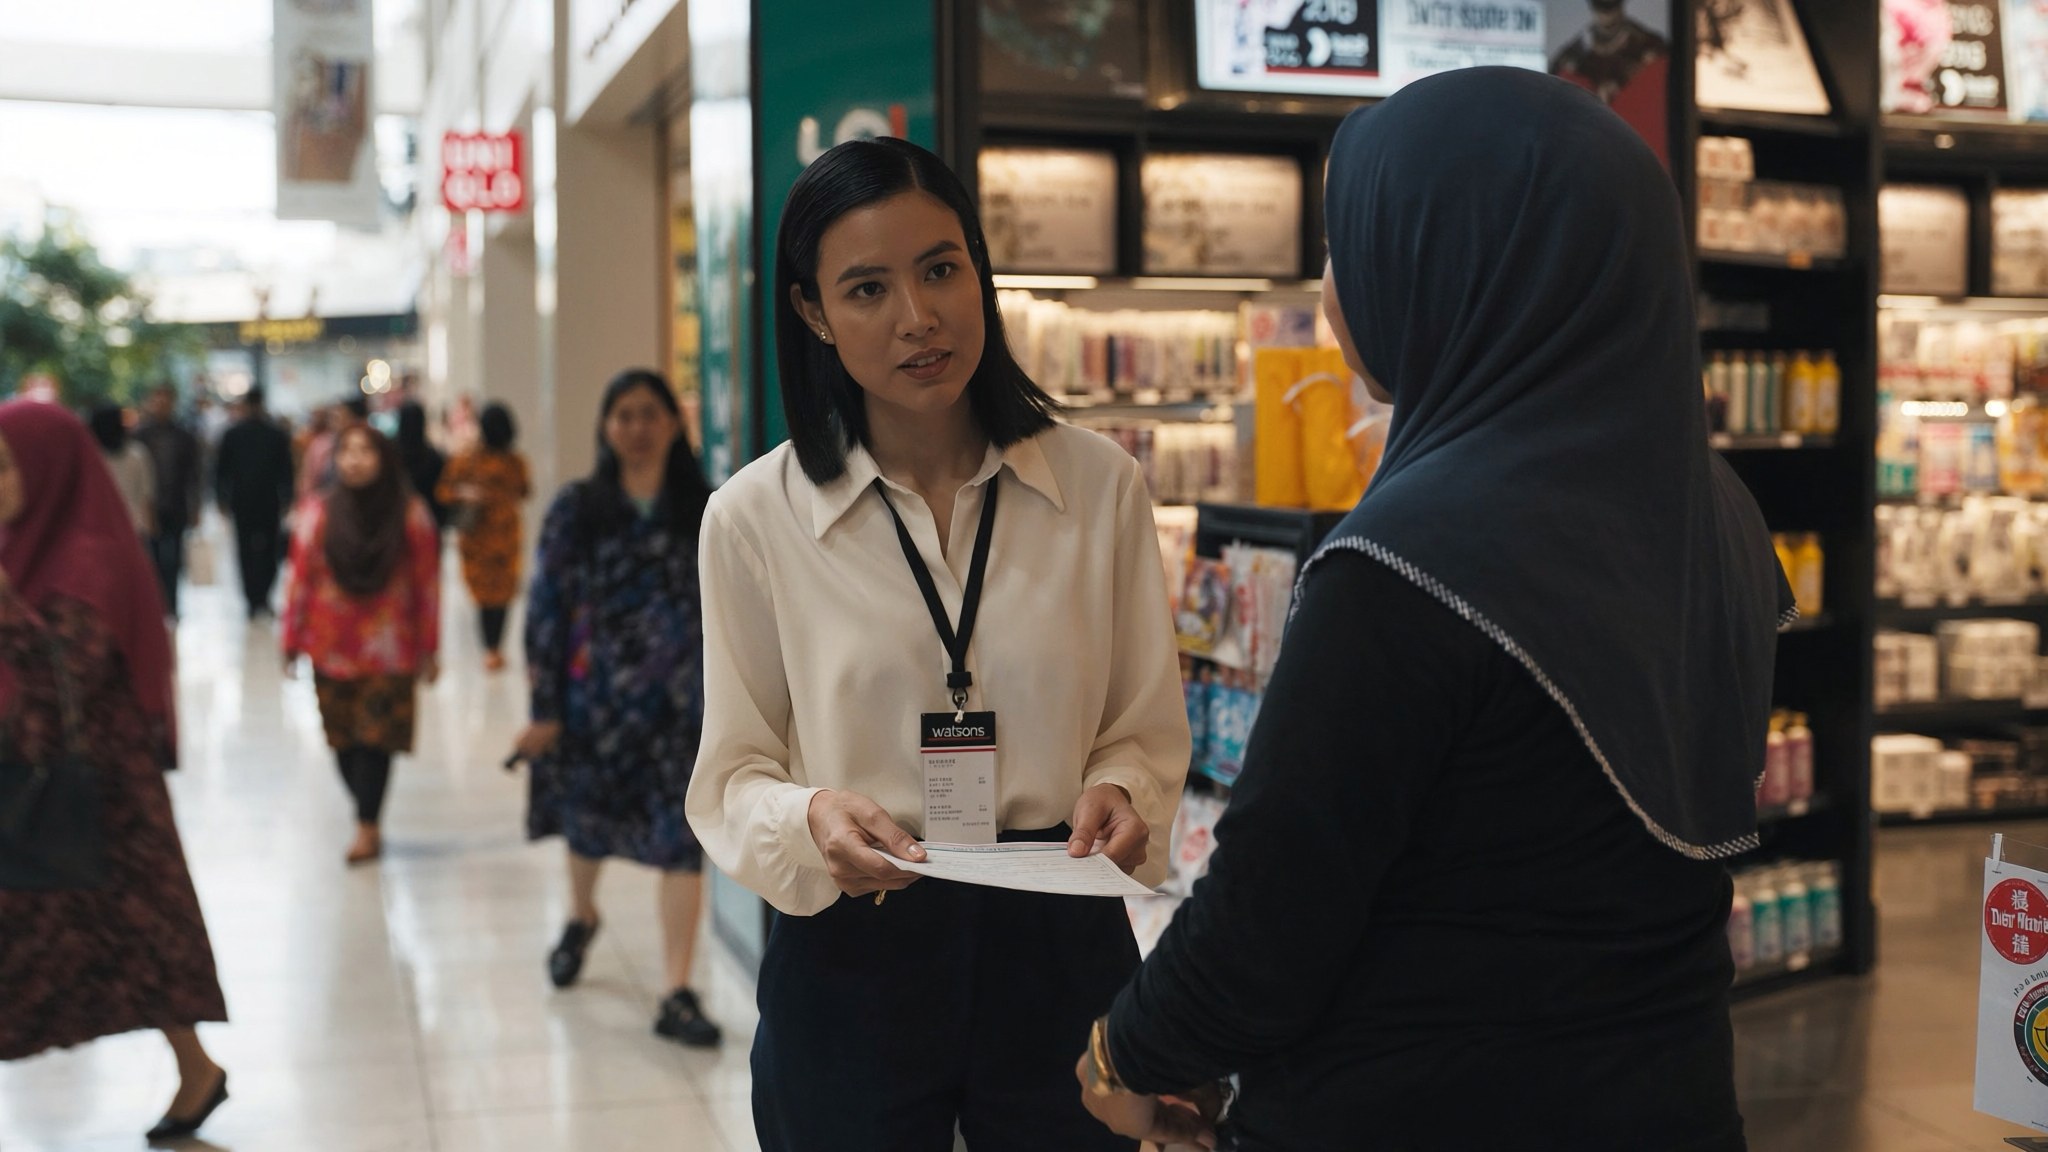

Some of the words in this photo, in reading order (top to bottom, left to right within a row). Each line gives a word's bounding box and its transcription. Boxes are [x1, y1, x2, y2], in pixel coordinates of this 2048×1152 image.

[444, 137, 513, 171] UNI
[445, 170, 521, 209] QLO
[932, 725, 985, 738] watsons
